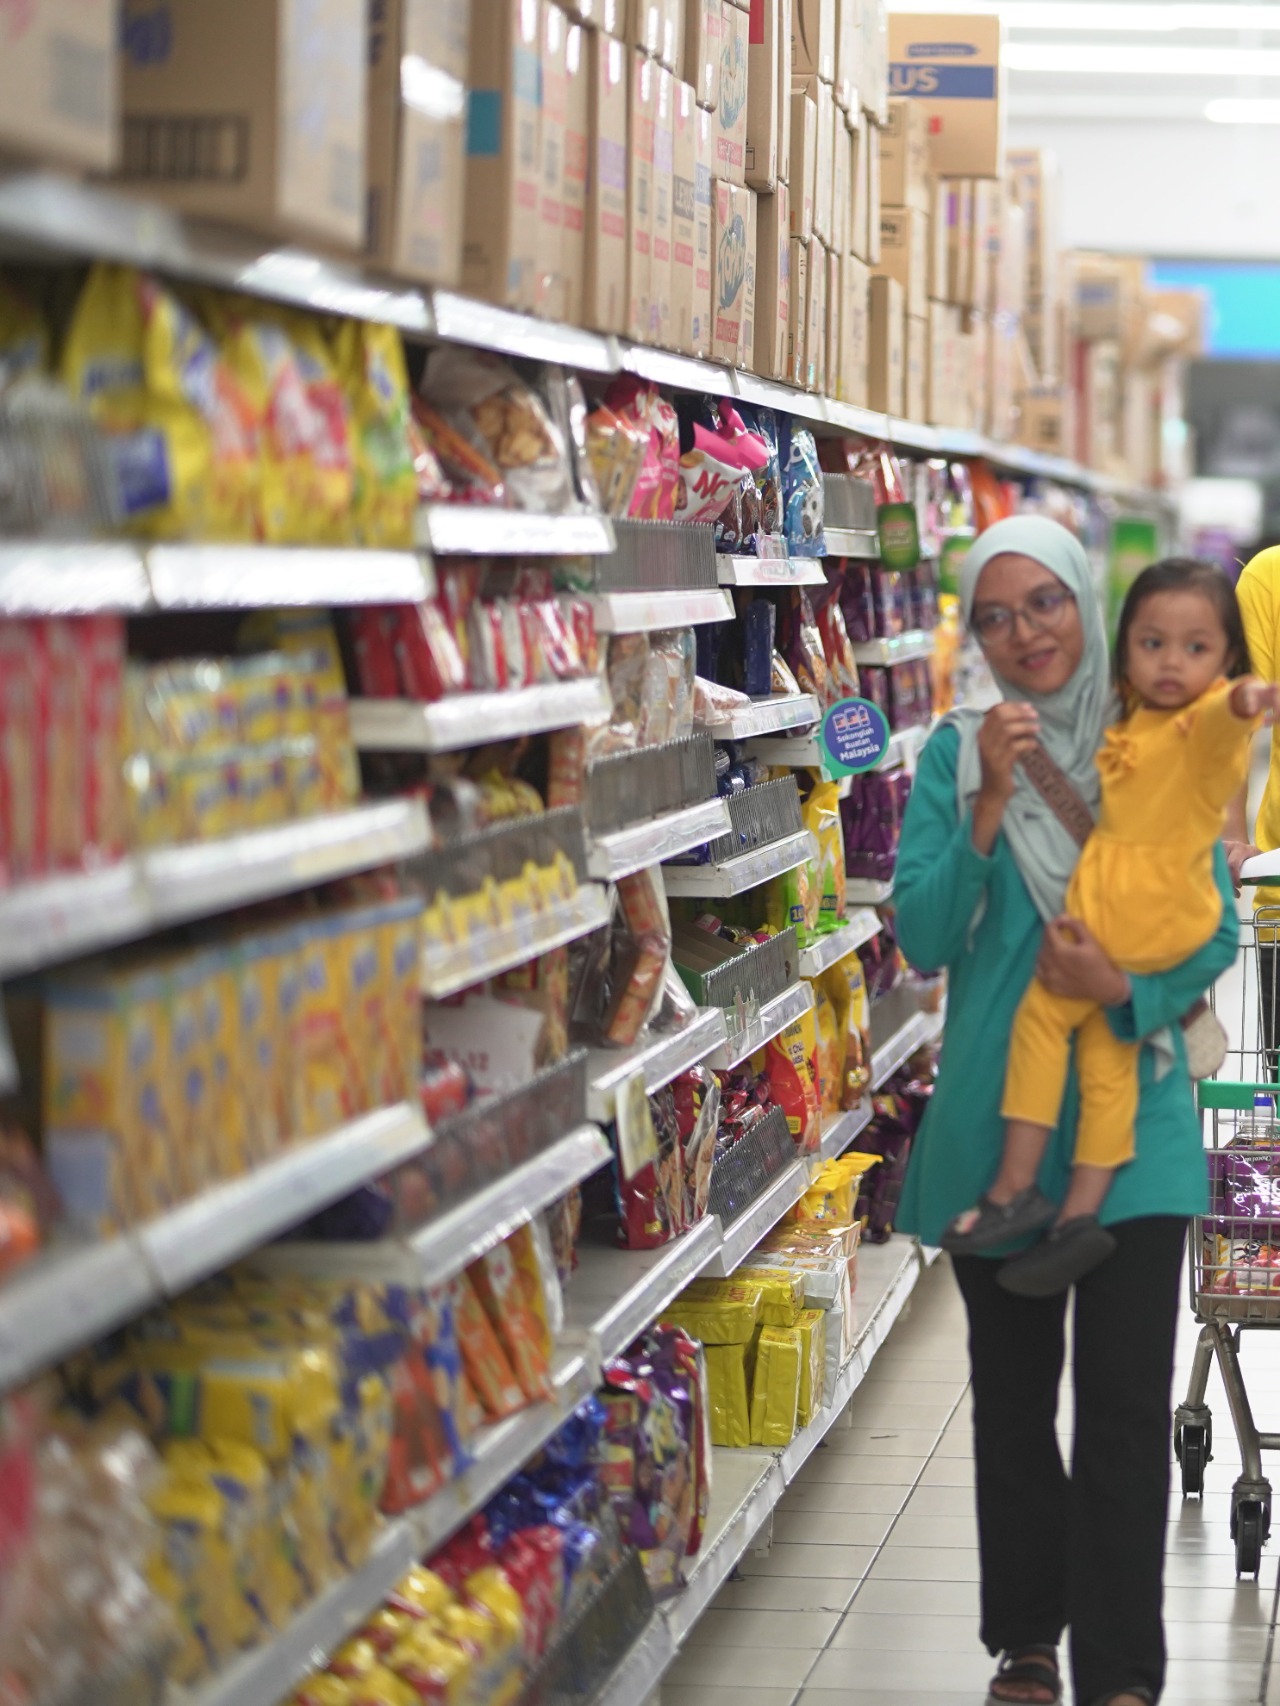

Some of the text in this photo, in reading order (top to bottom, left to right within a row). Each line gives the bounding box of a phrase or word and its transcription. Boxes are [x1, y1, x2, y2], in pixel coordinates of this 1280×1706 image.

[836, 727, 874, 743] Sokonglah
[844, 738, 871, 750] Buatan
[840, 744, 880, 761] Malaysia
